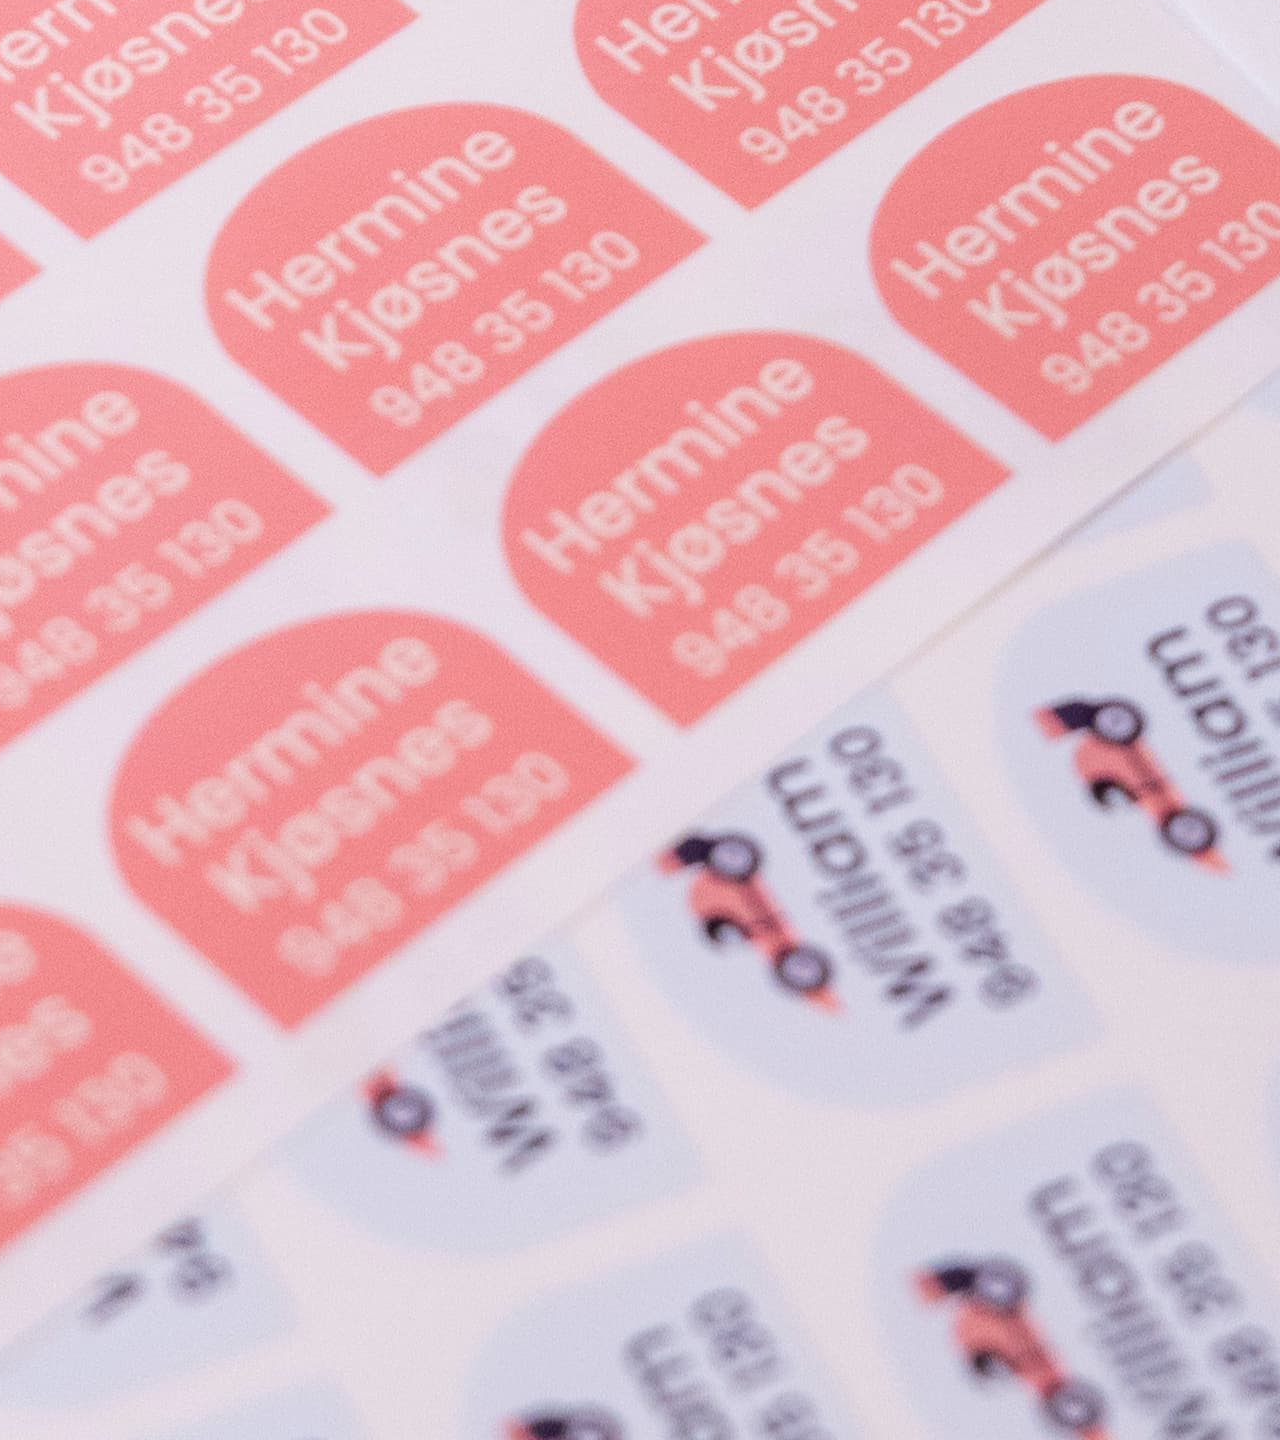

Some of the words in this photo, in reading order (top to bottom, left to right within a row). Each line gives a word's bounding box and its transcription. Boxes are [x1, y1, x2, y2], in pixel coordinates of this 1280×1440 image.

[224, 128, 516, 331] Hermine
[298, 184, 568, 371] Kjøsnes
[890, 101, 1165, 299] Hermine
[966, 155, 1220, 339] Kjøsnes
[369, 340, 485, 426] 948
[473, 289, 554, 353] 35
[539, 230, 640, 303] 130
[1041, 310, 1150, 393] 948
[1137, 260, 1214, 321] 35
